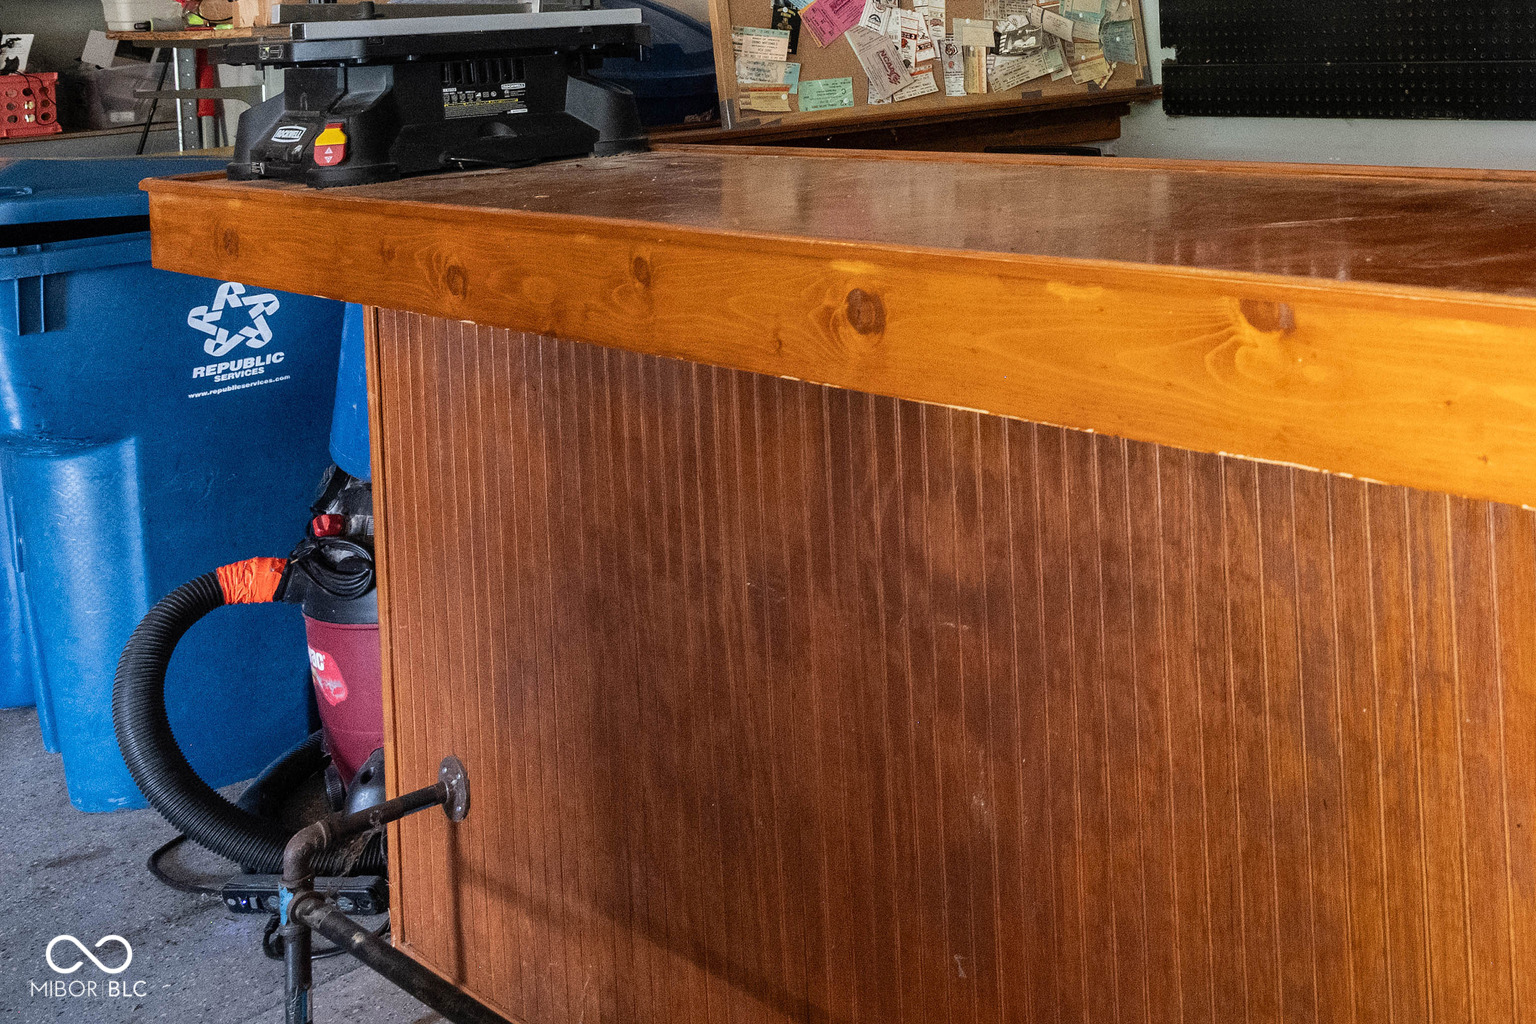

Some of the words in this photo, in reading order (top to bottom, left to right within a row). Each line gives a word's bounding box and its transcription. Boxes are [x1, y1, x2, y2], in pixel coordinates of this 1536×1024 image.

[192, 351, 285, 379] REPUBLIC
[214, 367, 265, 383] SERVICES
[188, 375, 291, 399] www.republicservices.com
